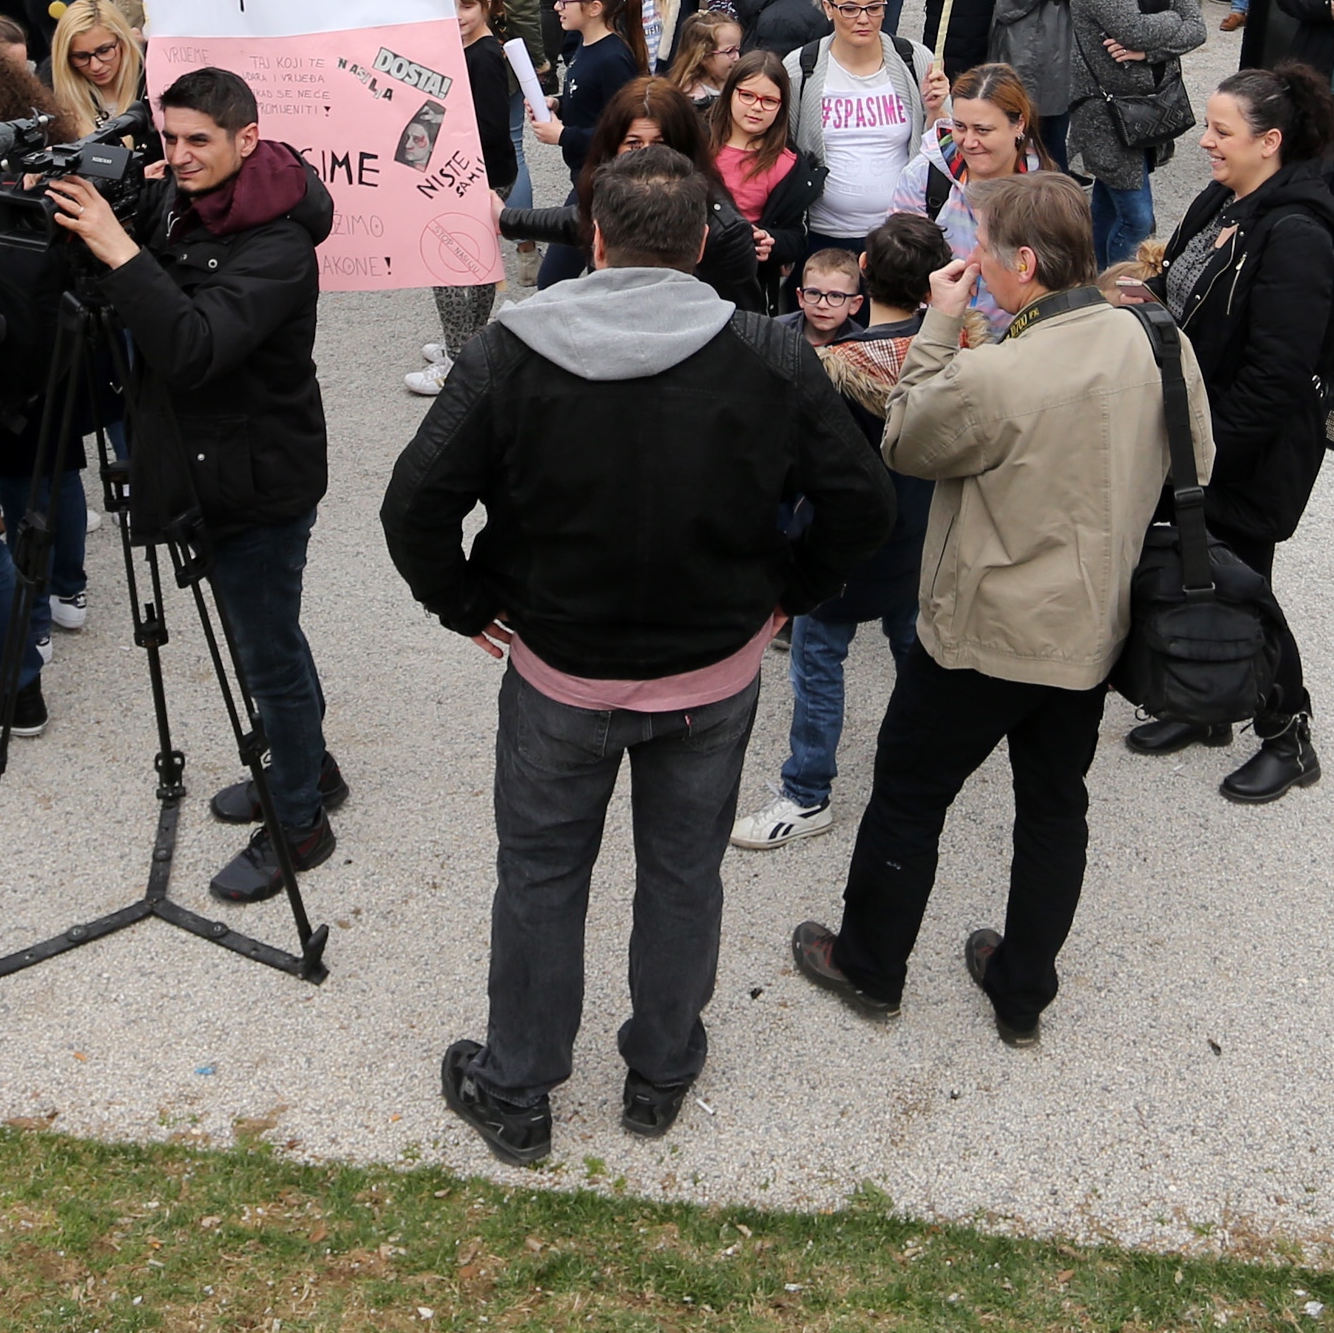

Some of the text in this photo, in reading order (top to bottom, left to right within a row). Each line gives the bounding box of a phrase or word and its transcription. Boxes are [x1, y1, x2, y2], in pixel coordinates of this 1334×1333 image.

[249, 55, 325, 70] TAJ KOJI TE
[373, 48, 453, 100] DOSTA!
[276, 90, 293, 99] SE
[821, 94, 907, 129] #SPASIME
[416, 149, 471, 200] NISTE
[329, 211, 385, 239] ŽIMO
[432, 225, 453, 247] STOP
